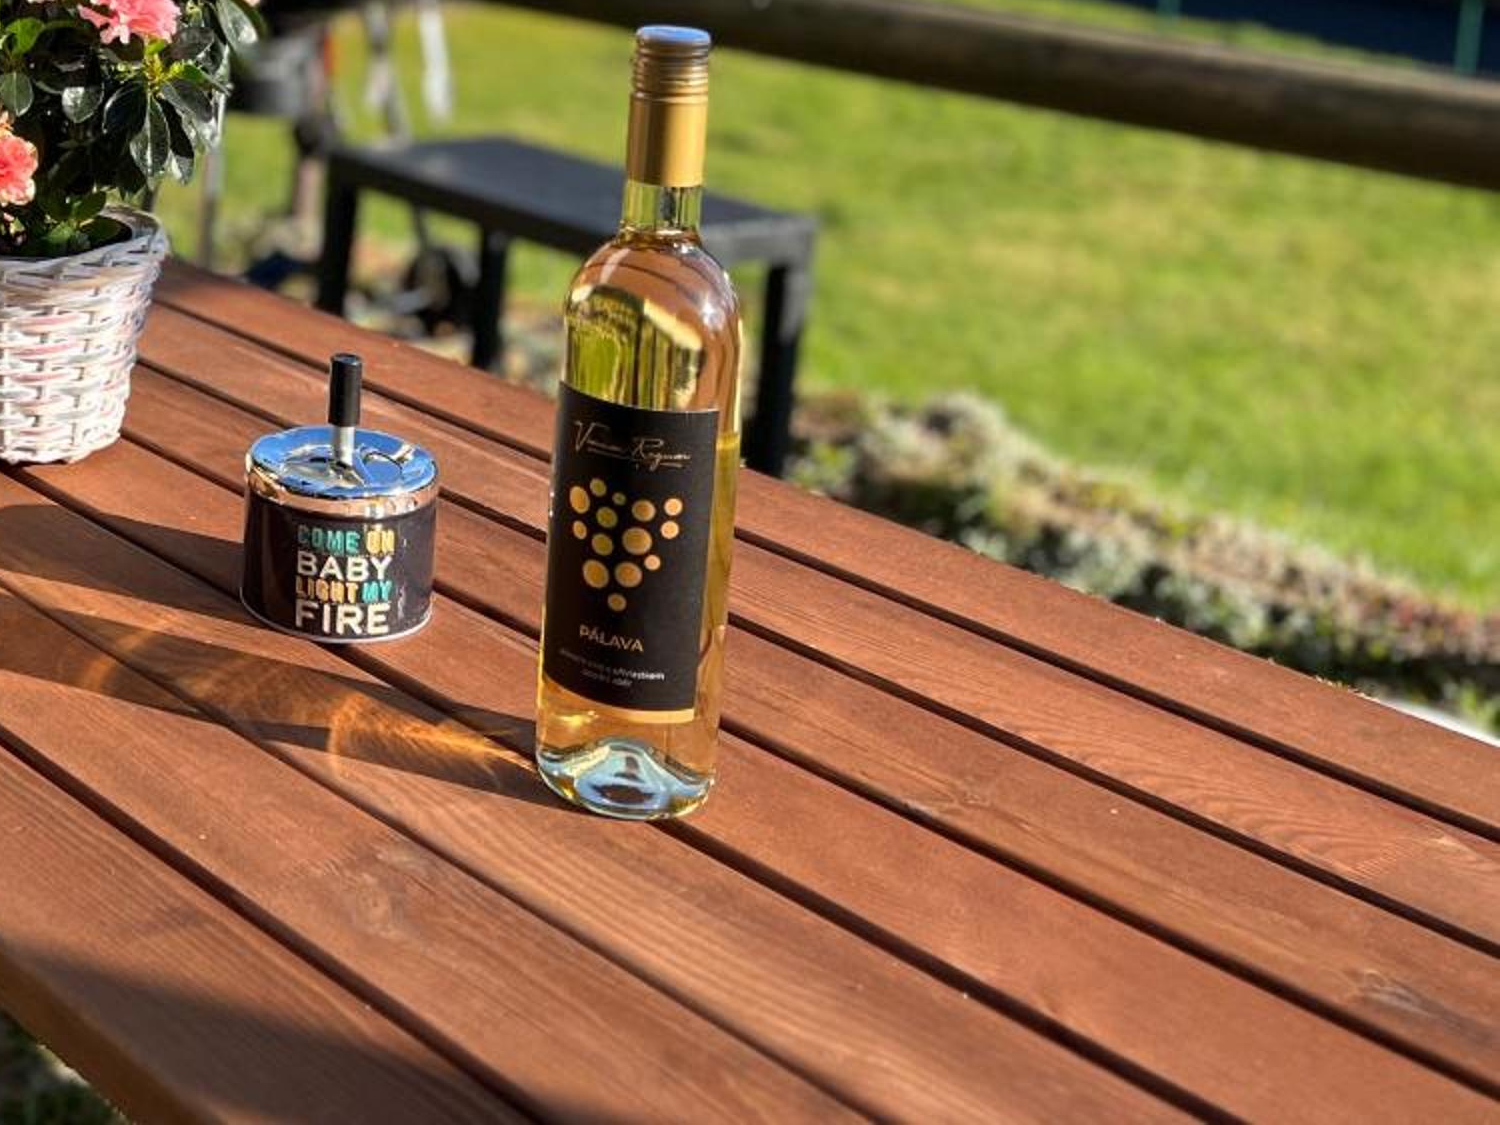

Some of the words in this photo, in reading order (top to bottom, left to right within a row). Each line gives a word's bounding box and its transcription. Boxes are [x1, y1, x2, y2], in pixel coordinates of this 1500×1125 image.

[297, 524, 361, 555] COME
[365, 527, 396, 556] ON
[296, 550, 393, 582] BABY
[296, 576, 359, 604] LIGHT
[361, 580, 393, 604] MY
[295, 600, 392, 635] FIRE
[579, 623, 644, 652] PÁLAVA
